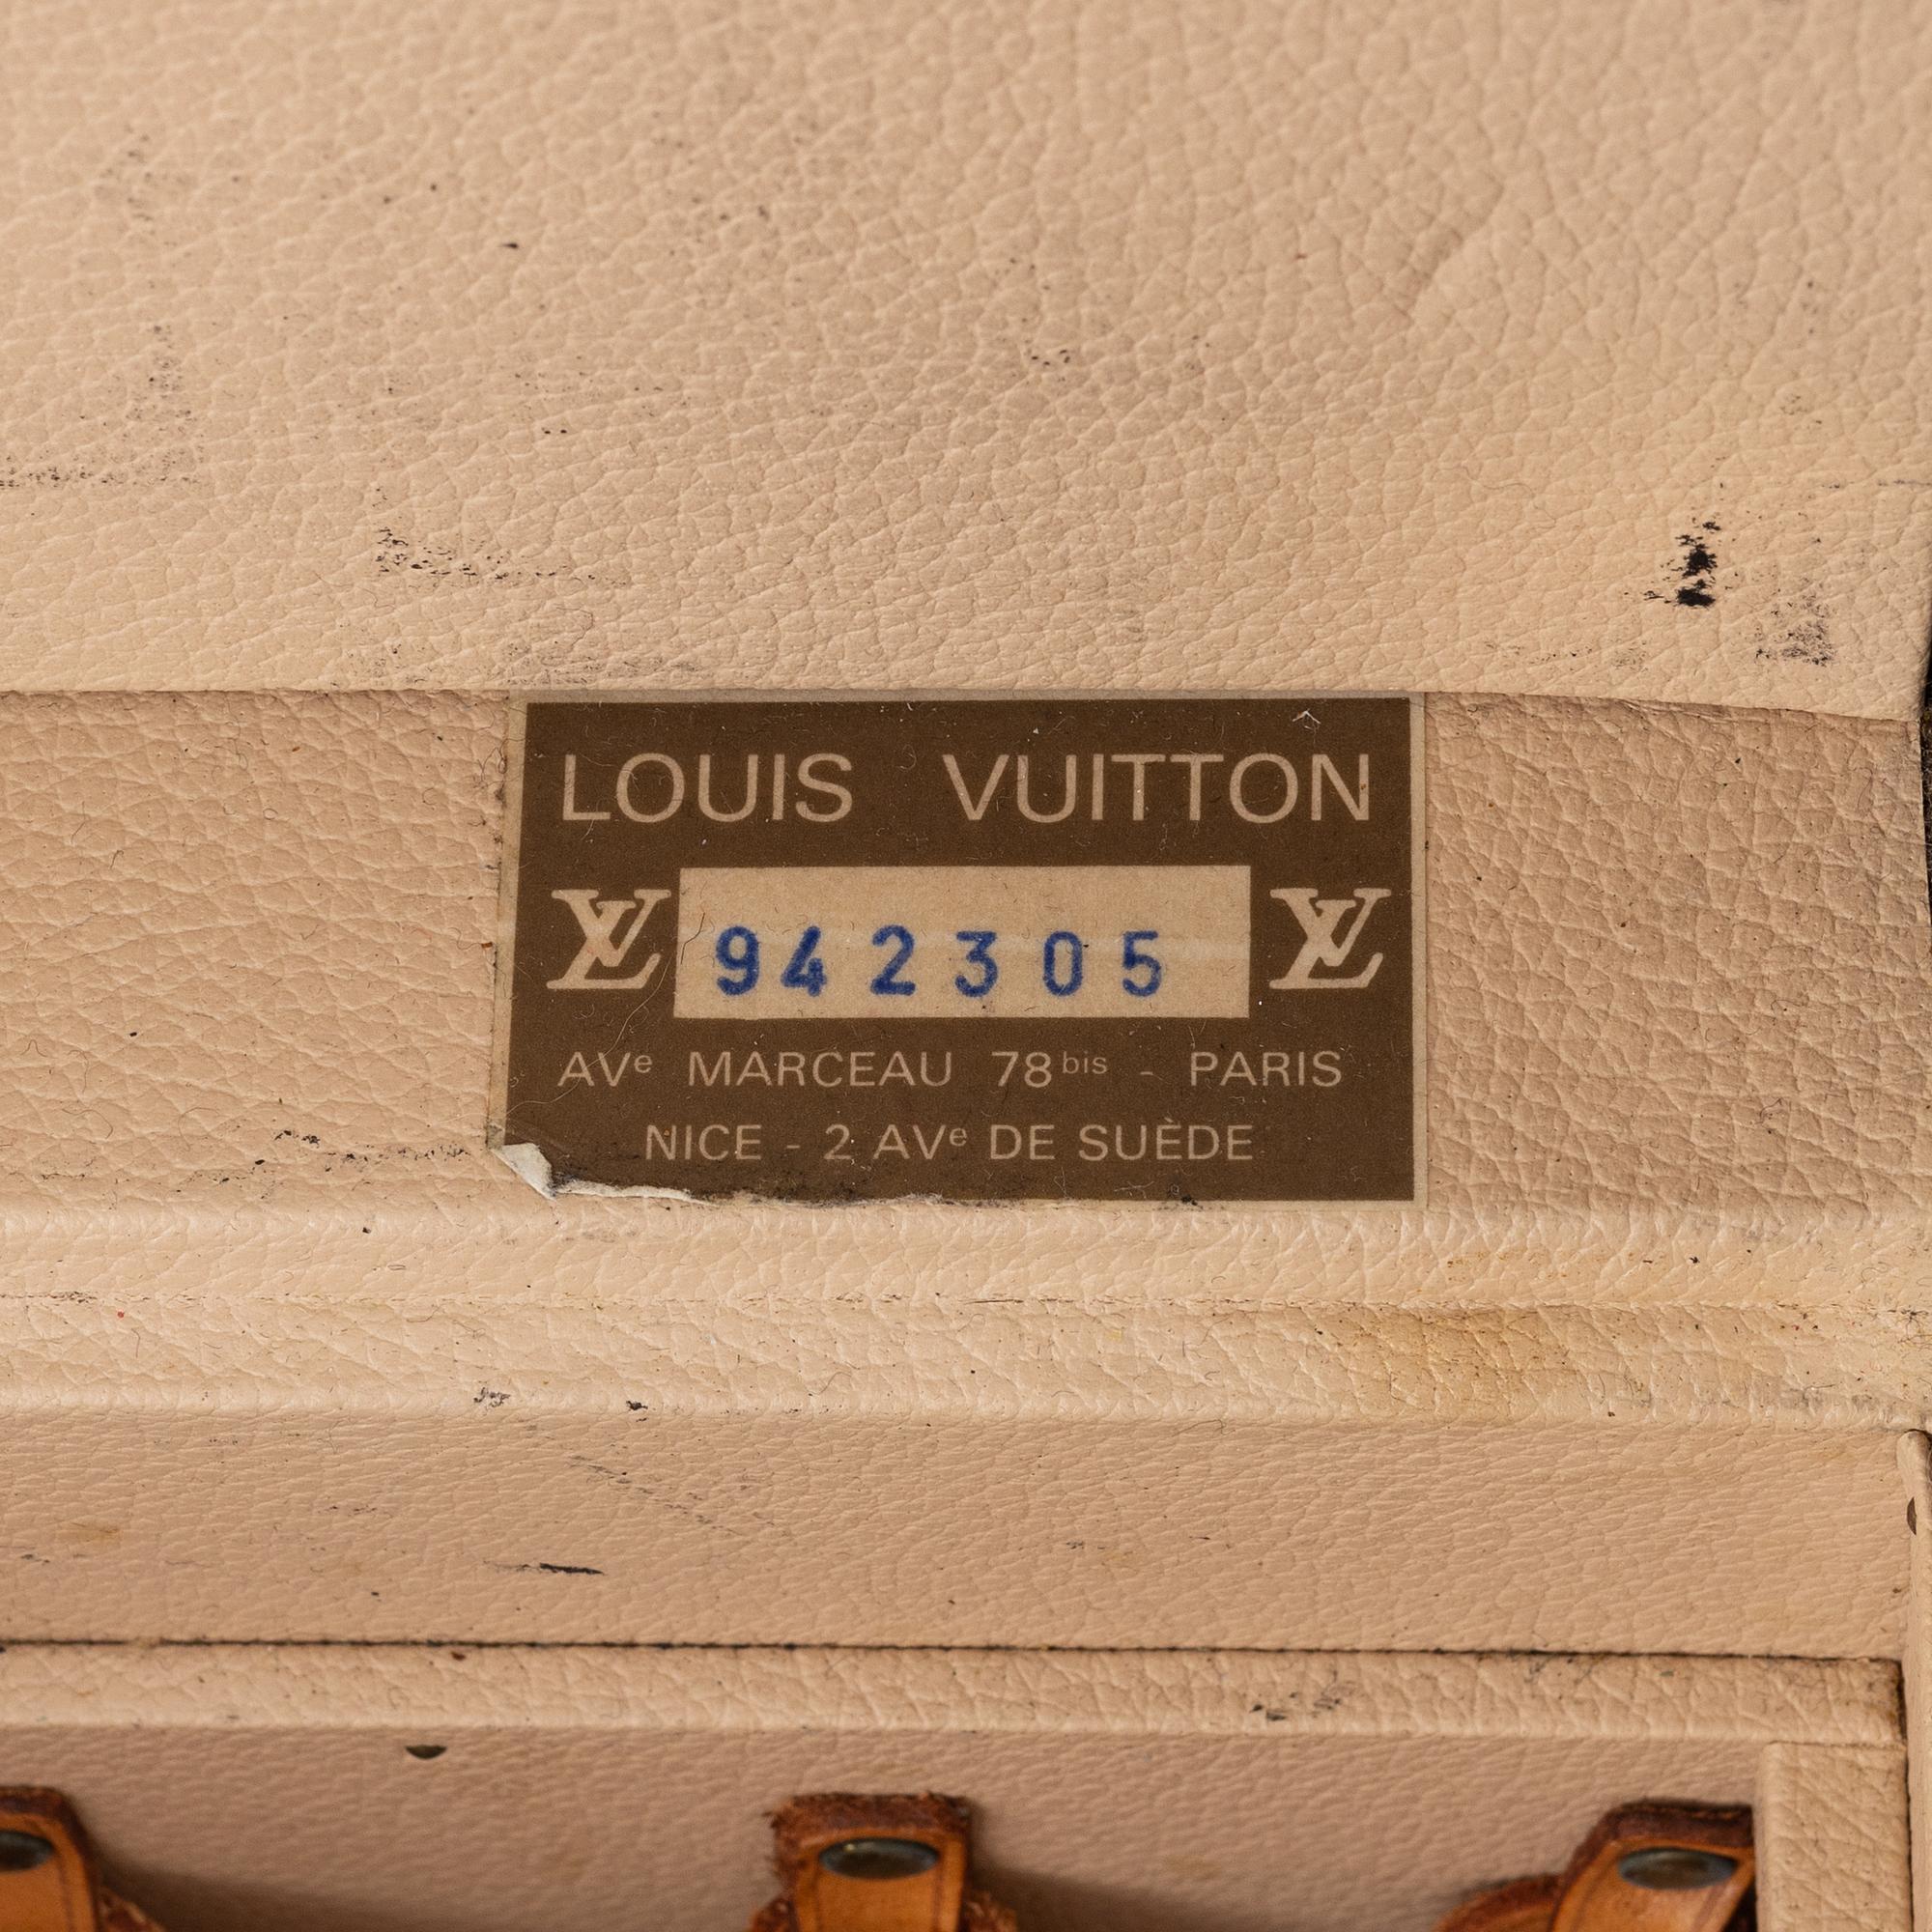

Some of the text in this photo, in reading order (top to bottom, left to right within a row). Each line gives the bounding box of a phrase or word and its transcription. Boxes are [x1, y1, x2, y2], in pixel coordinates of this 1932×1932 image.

[562, 753, 1370, 823] LOUIS VUITTON
[688, 1050, 952, 1088] MARCEAU
[1190, 1049, 1343, 1088] PARIS
[646, 1124, 762, 1160] NICE
[824, 1123, 852, 1160] 2
[990, 1123, 1056, 1160] DE
[1078, 1117, 1254, 1161] SUÈDE
